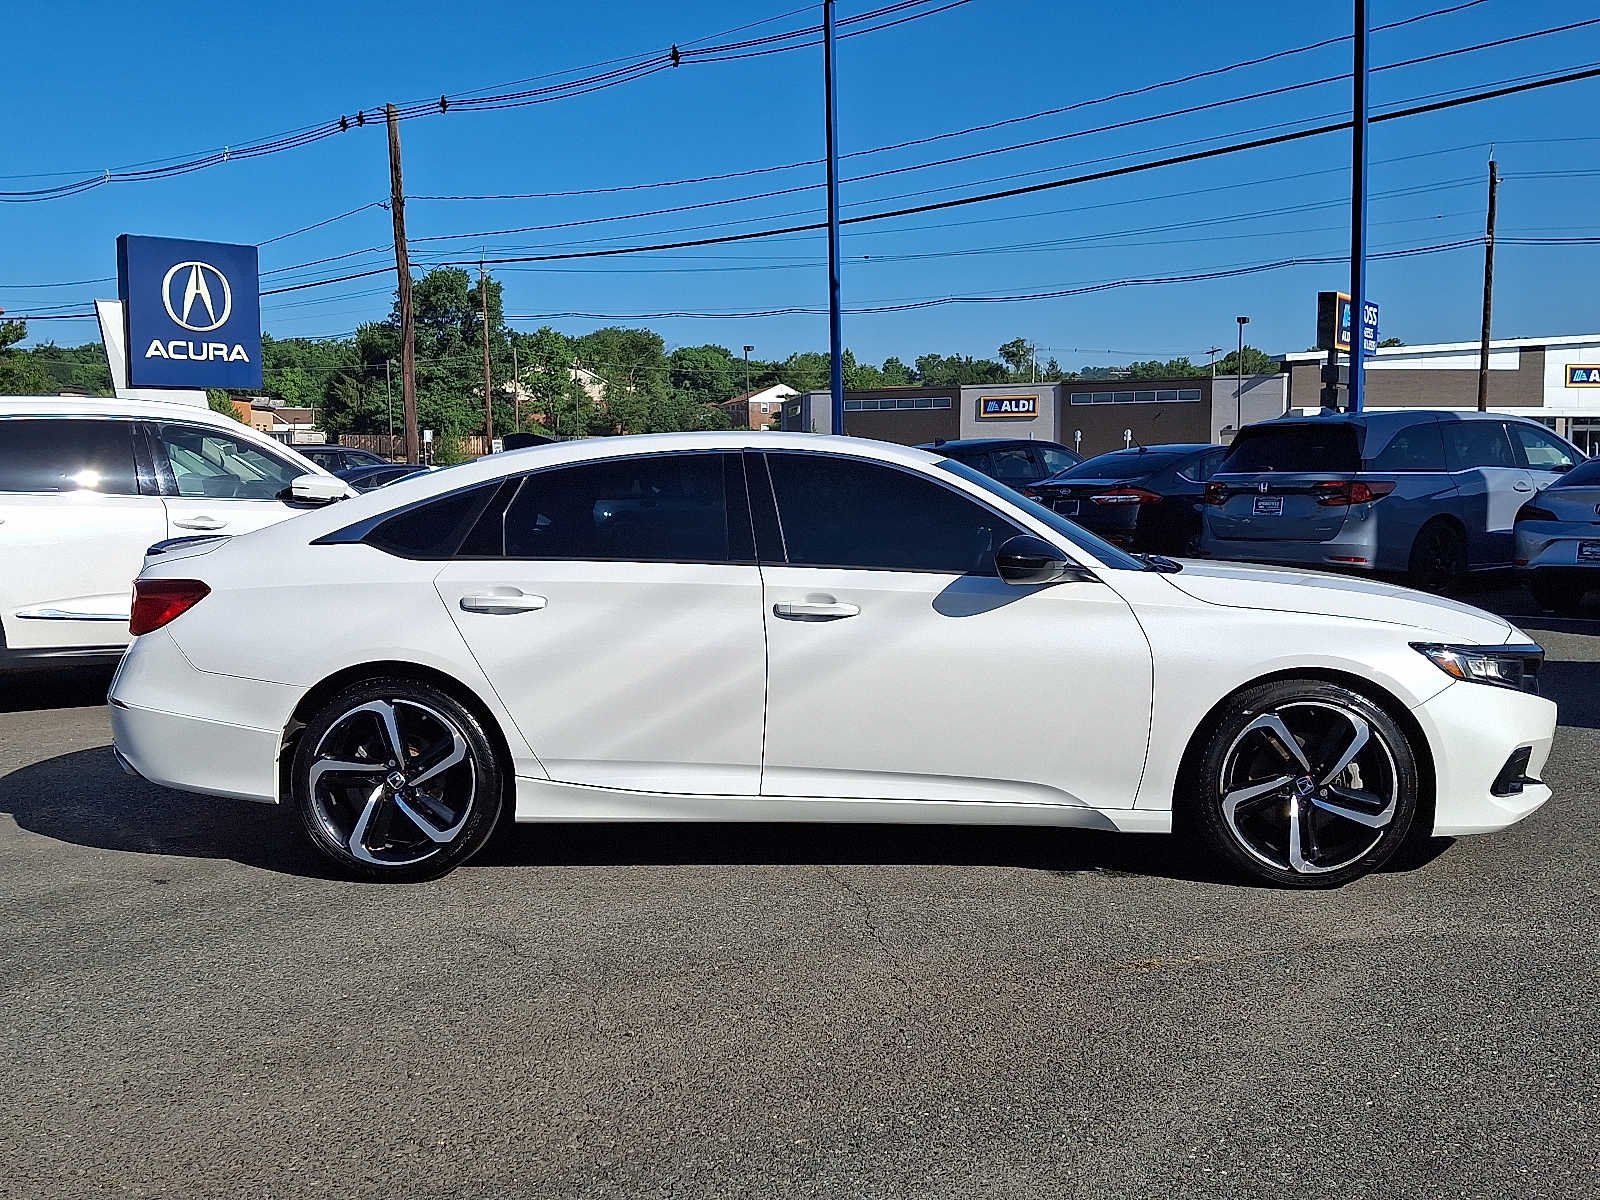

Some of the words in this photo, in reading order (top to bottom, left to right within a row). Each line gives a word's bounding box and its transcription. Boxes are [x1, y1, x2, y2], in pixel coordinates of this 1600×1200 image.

[1364, 305, 1377, 325] OSS
[145, 339, 249, 362] ACURA
[1001, 400, 1033, 412] ALDI
